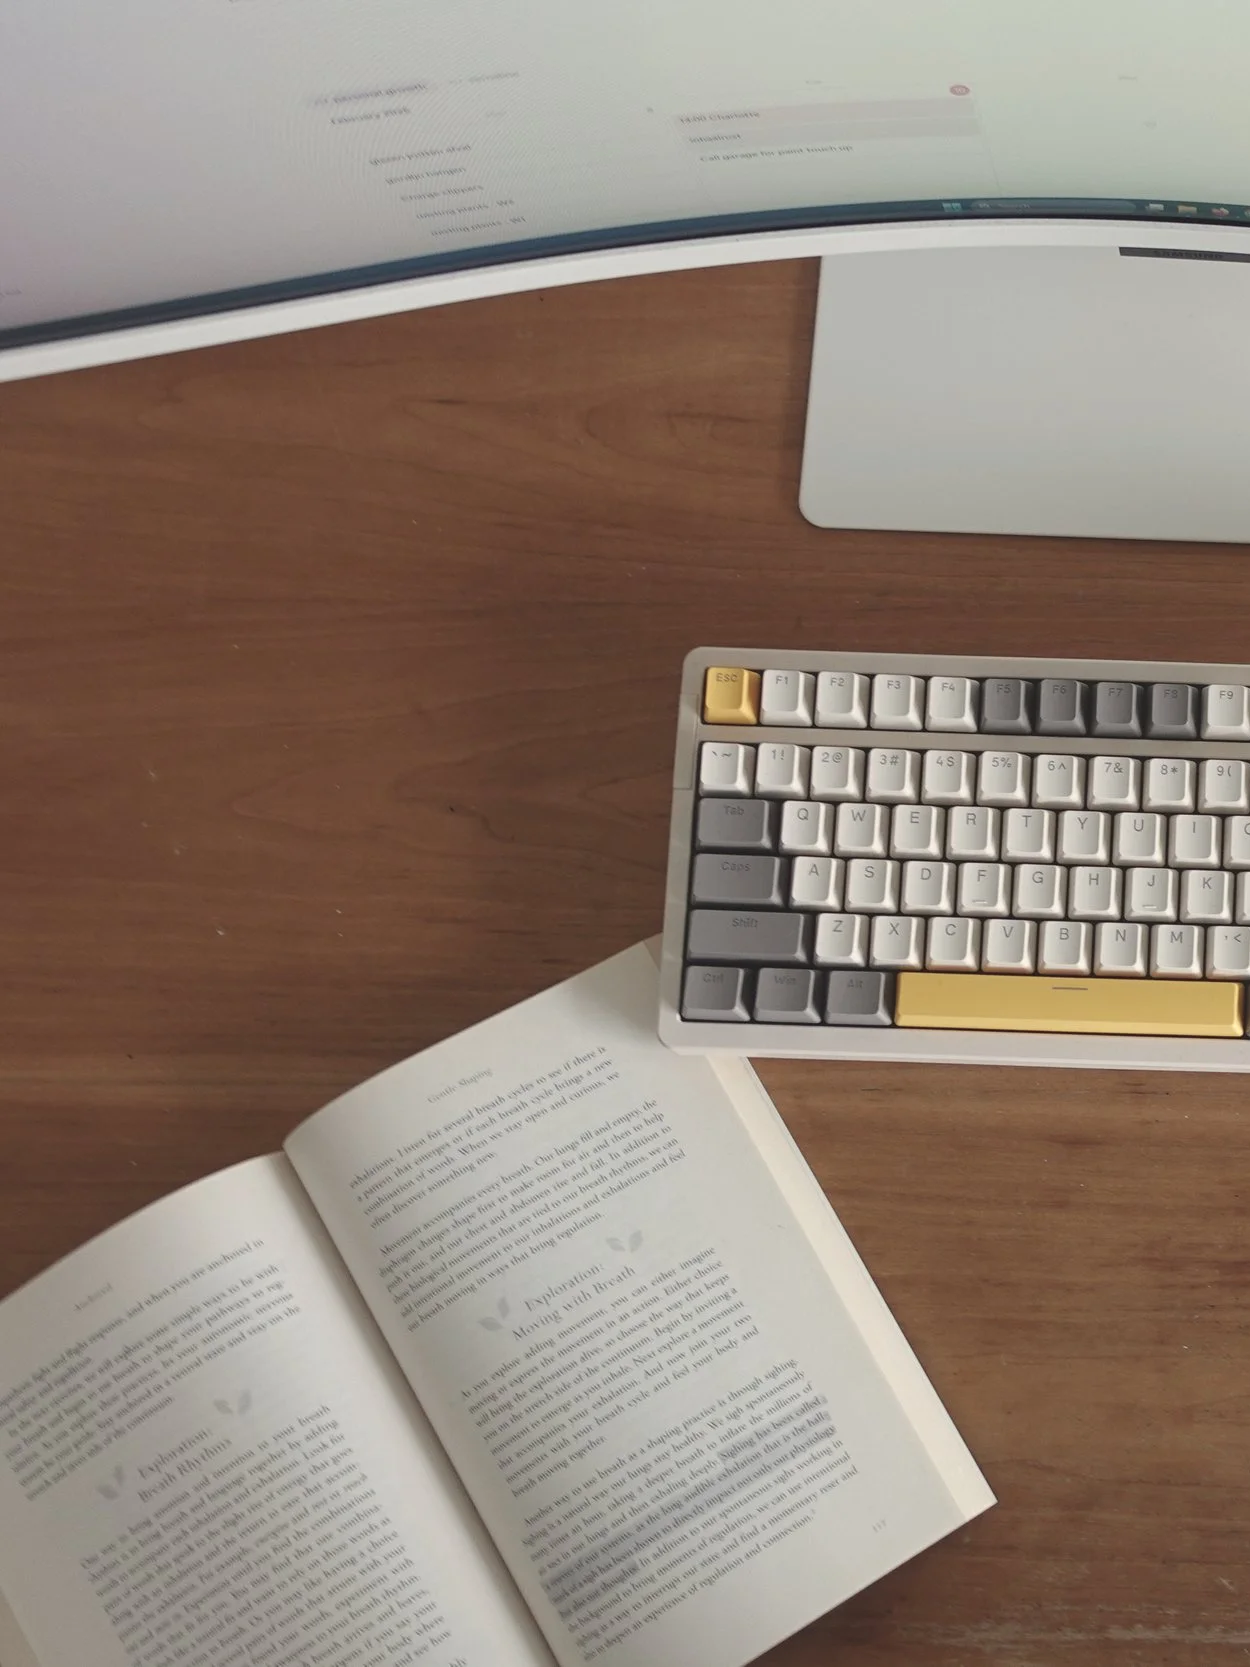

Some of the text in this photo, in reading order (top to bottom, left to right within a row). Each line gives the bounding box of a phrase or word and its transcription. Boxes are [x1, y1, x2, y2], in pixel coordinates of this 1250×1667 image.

[776, 675, 788, 684] F1
[830, 677, 845, 687] F2
[887, 680, 901, 689] F3
[941, 682, 955, 691] F4
[996, 684, 1011, 693] F5
[1052, 685, 1066, 694] F6
[1108, 688, 1123, 696] F7
[1164, 689, 1178, 698] F8
[1220, 690, 1233, 699] F9
[724, 805, 744, 816] Tab
[797, 808, 808, 820] Q
[851, 810, 866, 822] W
[910, 812, 919, 823] E
[966, 813, 976, 825] R
[1022, 815, 1032, 827] T
[1077, 817, 1088, 830] Y
[1134, 819, 1144, 832] U
[721, 860, 751, 871] Caps
[809, 864, 819, 876] A
[864, 866, 874, 878] S
[920, 868, 931, 880] D
[977, 870, 986, 881] F
[1032, 871, 1043, 883] G
[1089, 873, 1099, 885] H
[1147, 875, 1155, 887] J
[1203, 877, 1212, 889] K
[732, 917, 758, 928] Shift
[832, 920, 843, 932] Z
[889, 923, 899, 935] X
[945, 924, 956, 936] C
[1003, 926, 1013, 938] V
[1060, 928, 1069, 940] B
[1116, 929, 1126, 942] N
[1170, 931, 1183, 943] M
[475, 1096, 505, 1115] breath
[394, 1164, 412, 1177] that
[498, 1101, 528, 1119] breath
[512, 1266, 635, 1340] Moving with Breath
